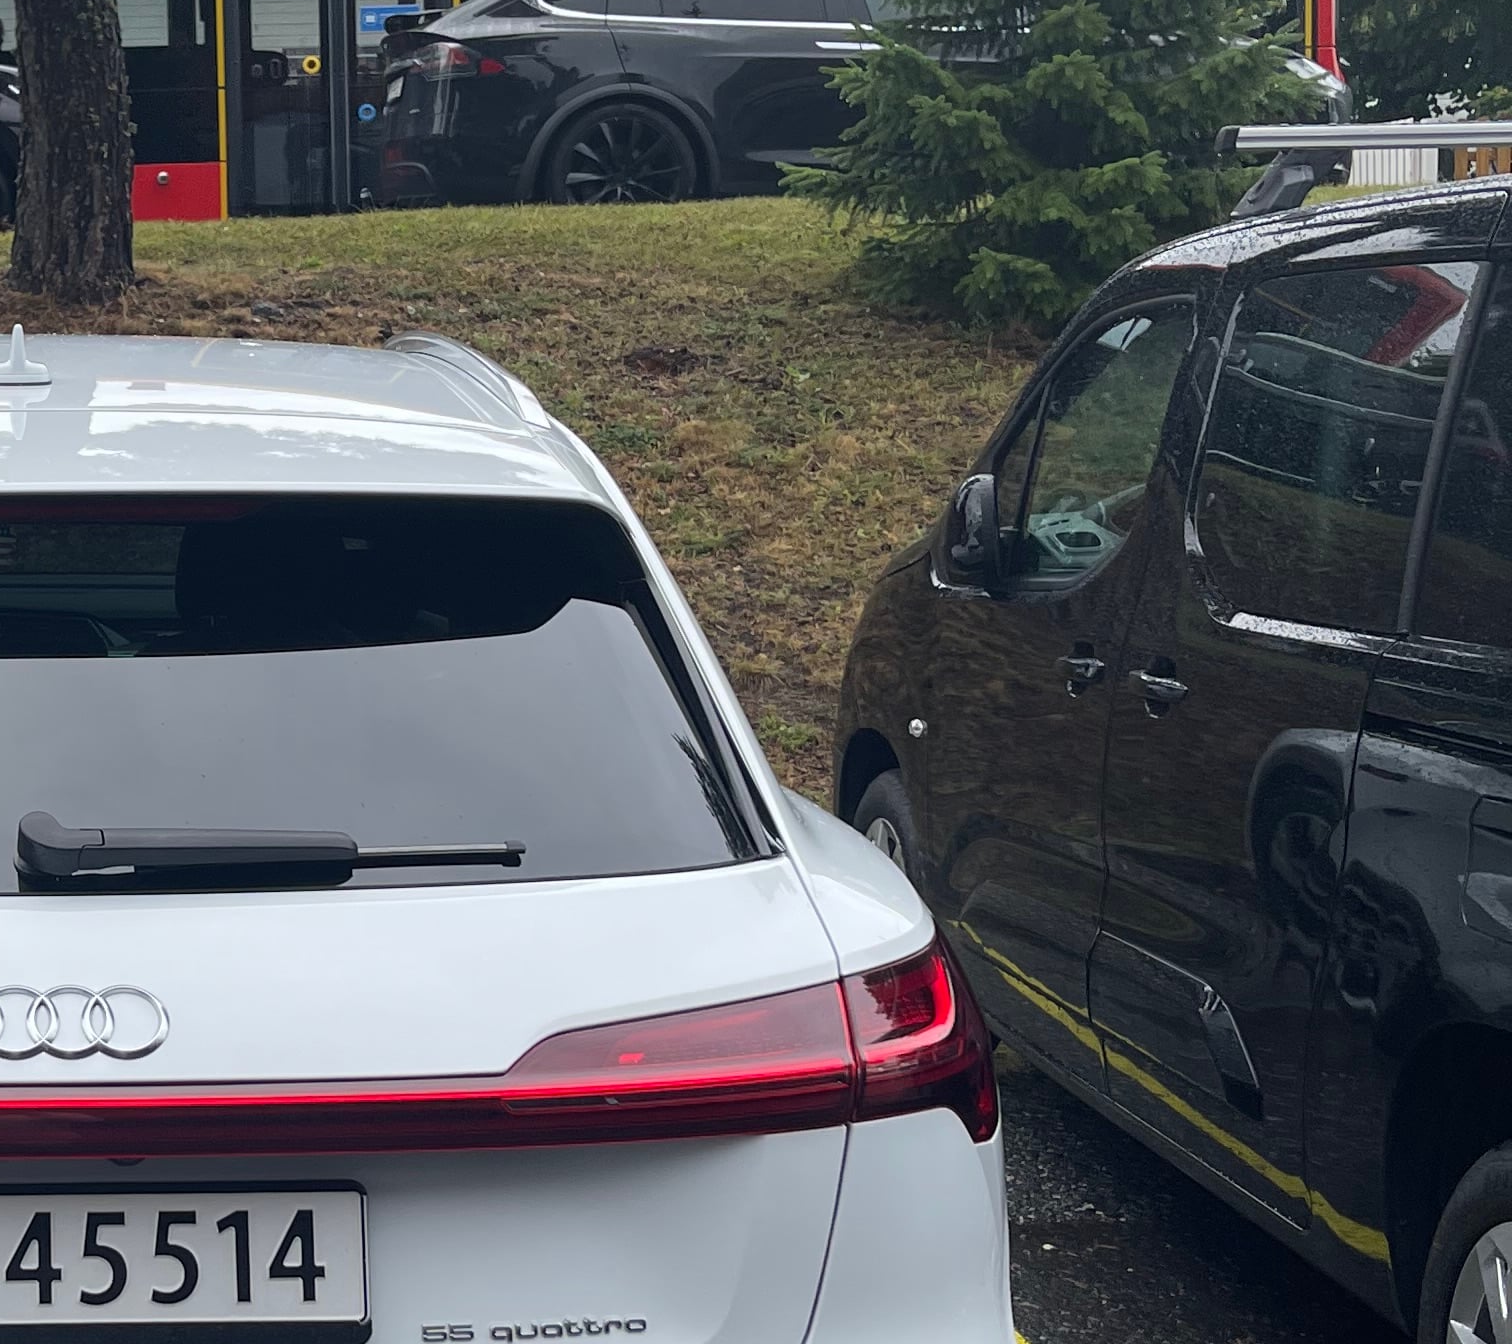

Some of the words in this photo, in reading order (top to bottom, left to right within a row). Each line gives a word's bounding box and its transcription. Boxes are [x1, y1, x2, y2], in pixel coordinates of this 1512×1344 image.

[4, 1208, 327, 1306] 45514
[421, 1323, 475, 1343] 55
[490, 1316, 648, 1344] quattro
